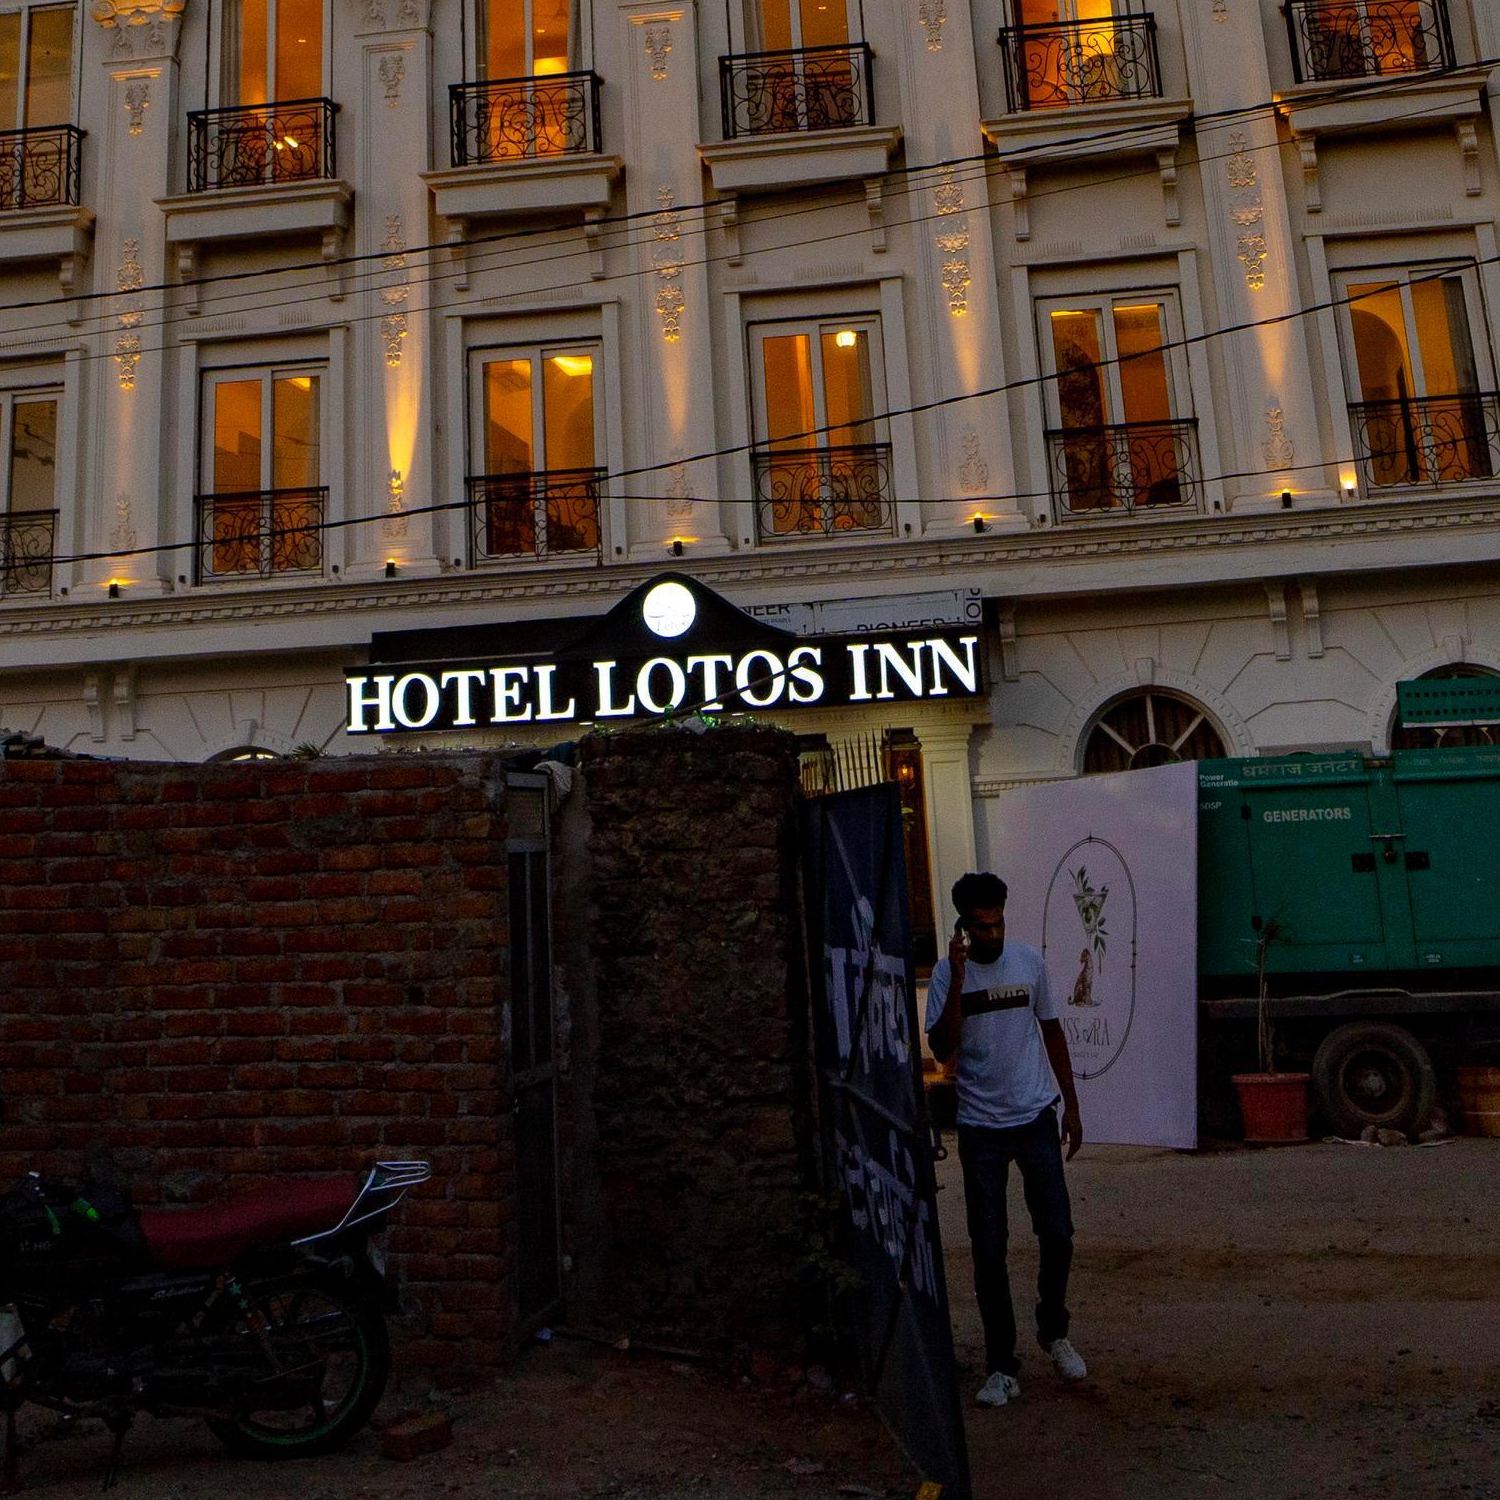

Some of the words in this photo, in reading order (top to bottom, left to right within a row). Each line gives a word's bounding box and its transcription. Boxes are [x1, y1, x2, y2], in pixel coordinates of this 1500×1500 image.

[347, 664, 574, 732] HOTEL
[594, 647, 825, 718] LOTOS
[848, 636, 979, 700] INN
[1263, 807, 1351, 823] GENERATORS
